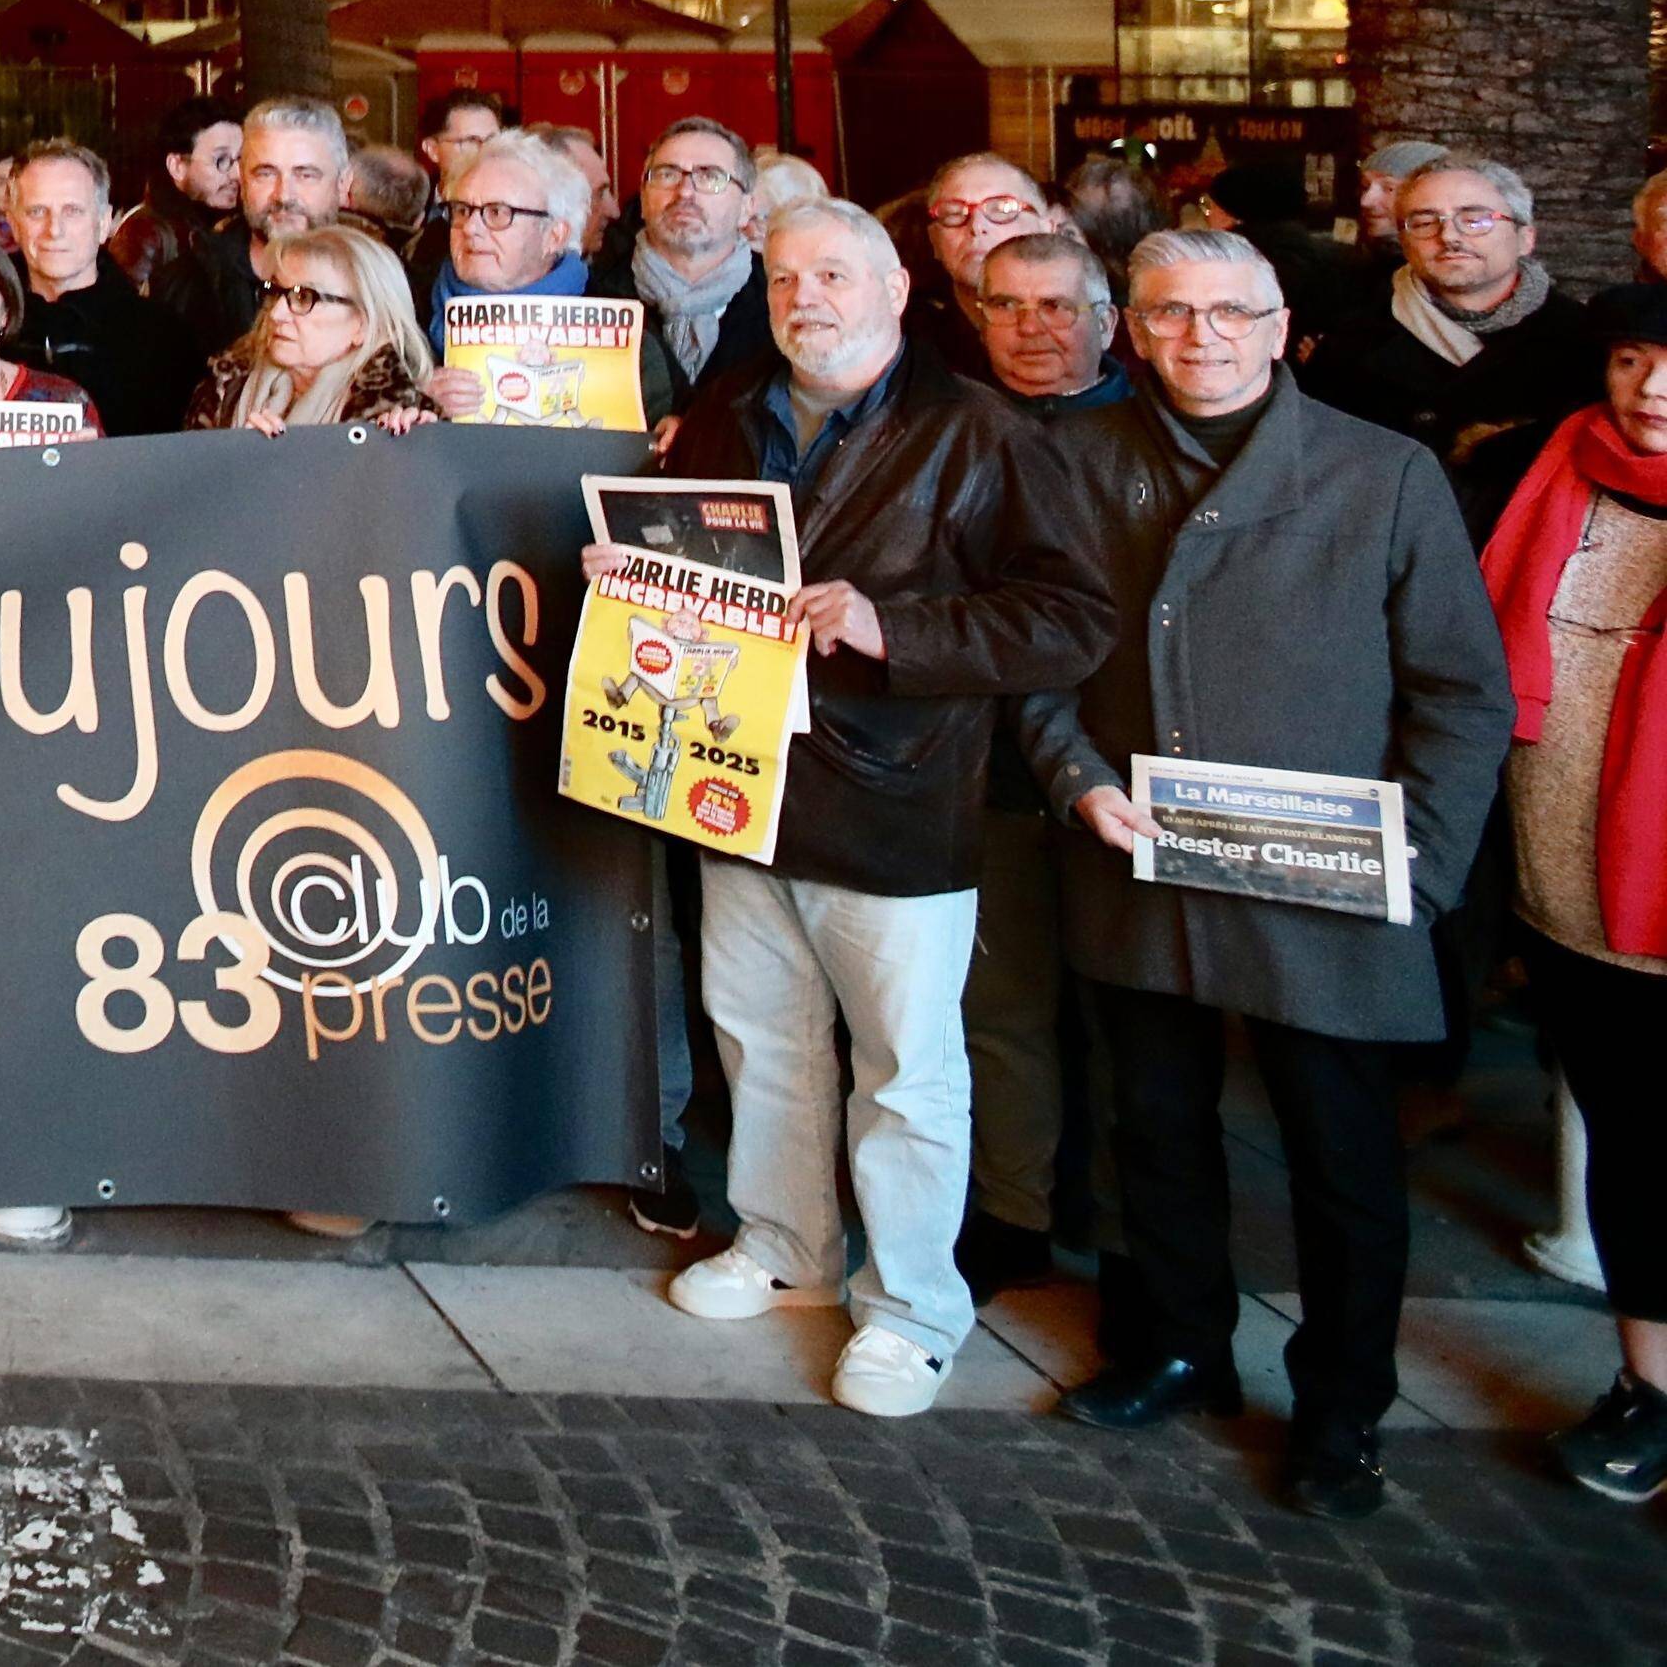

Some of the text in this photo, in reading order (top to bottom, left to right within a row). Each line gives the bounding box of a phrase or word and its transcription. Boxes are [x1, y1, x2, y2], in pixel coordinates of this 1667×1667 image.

[447, 303, 635, 328] CHARLIE HEBDO
[0, 411, 77, 434] HEBDO
[701, 500, 764, 520] CHARLIE
[709, 577, 791, 618] HEBD
[582, 709, 646, 742] 2015
[689, 741, 761, 776] 2025
[1175, 782, 1201, 801] La
[1206, 786, 1353, 818] Marseillaise
[1156, 830, 1382, 876] Rester Charlie
[290, 854, 551, 946] club de la
[75, 912, 553, 1062] 83 presse
